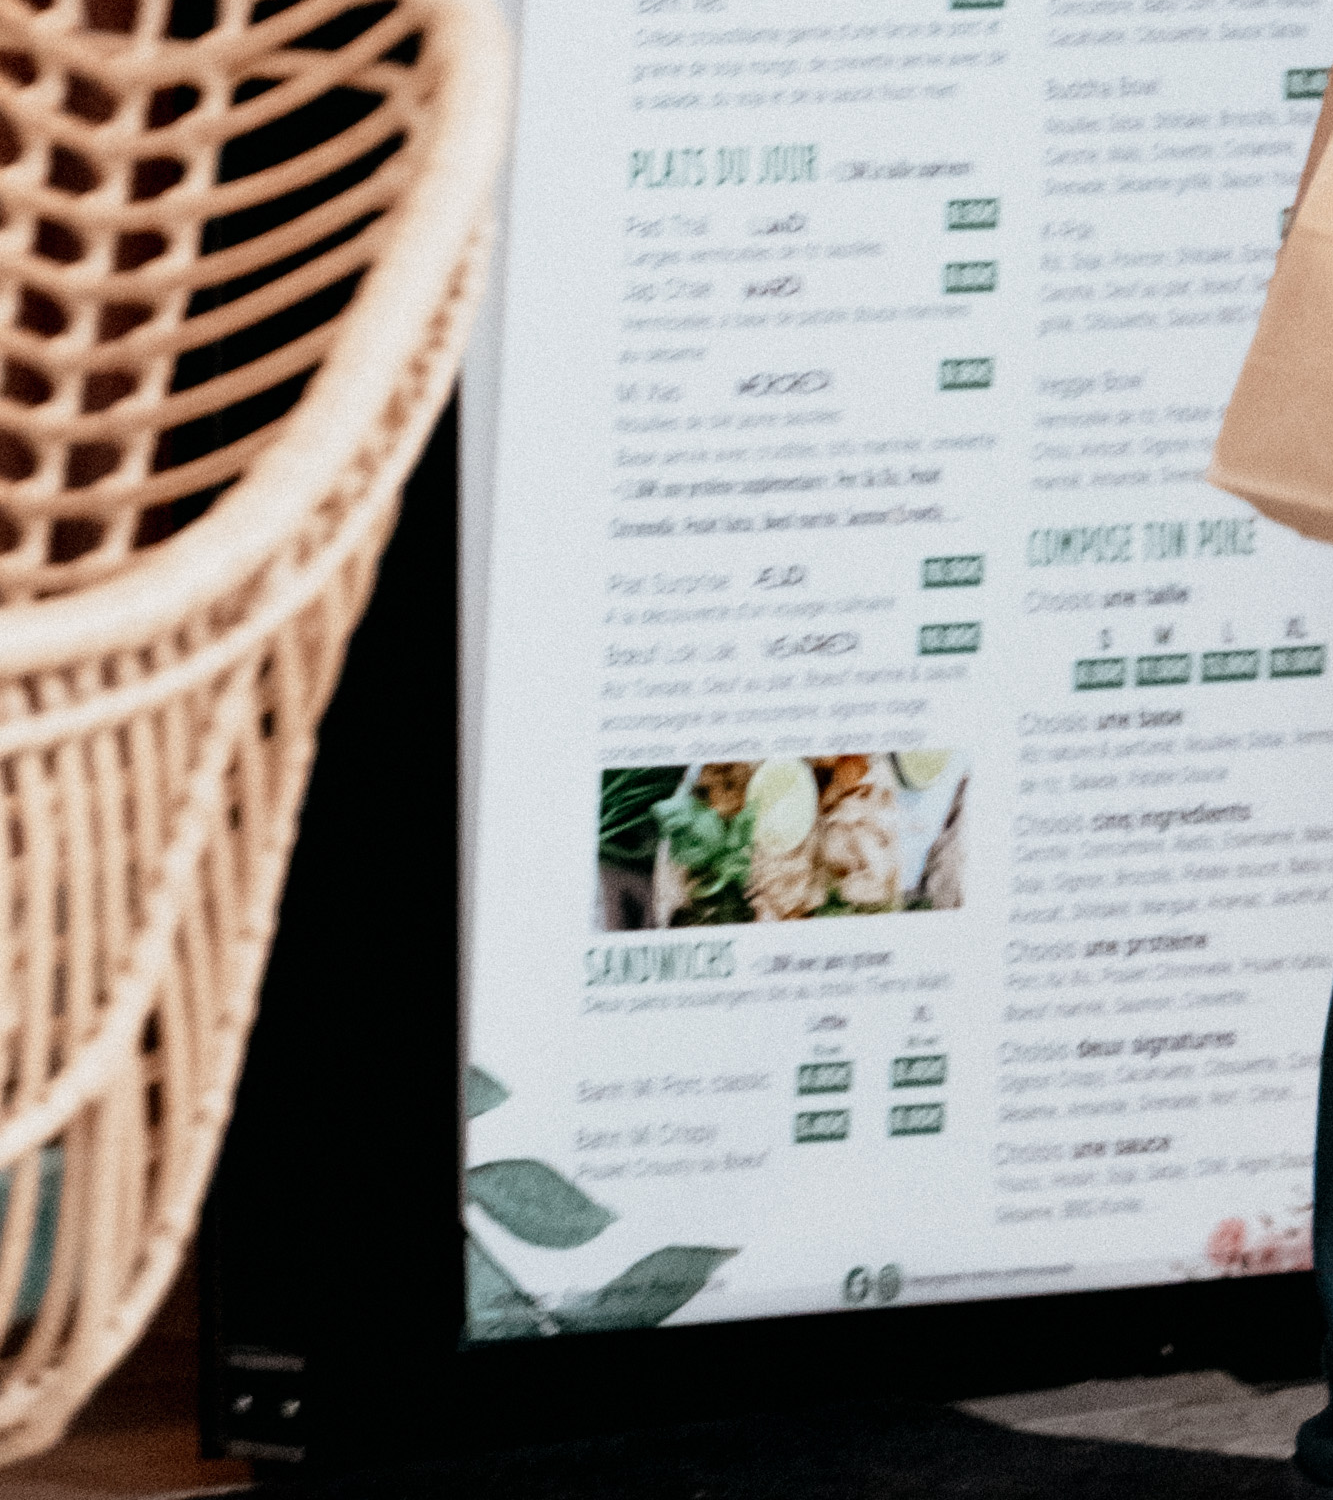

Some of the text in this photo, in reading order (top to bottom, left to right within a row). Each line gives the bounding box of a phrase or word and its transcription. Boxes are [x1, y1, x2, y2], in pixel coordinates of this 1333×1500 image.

[628, 142, 819, 189] PLATS DU JOUR
[1027, 516, 1258, 568] COMPOSE TON POKE
[585, 940, 736, 987] SANDWICHS
